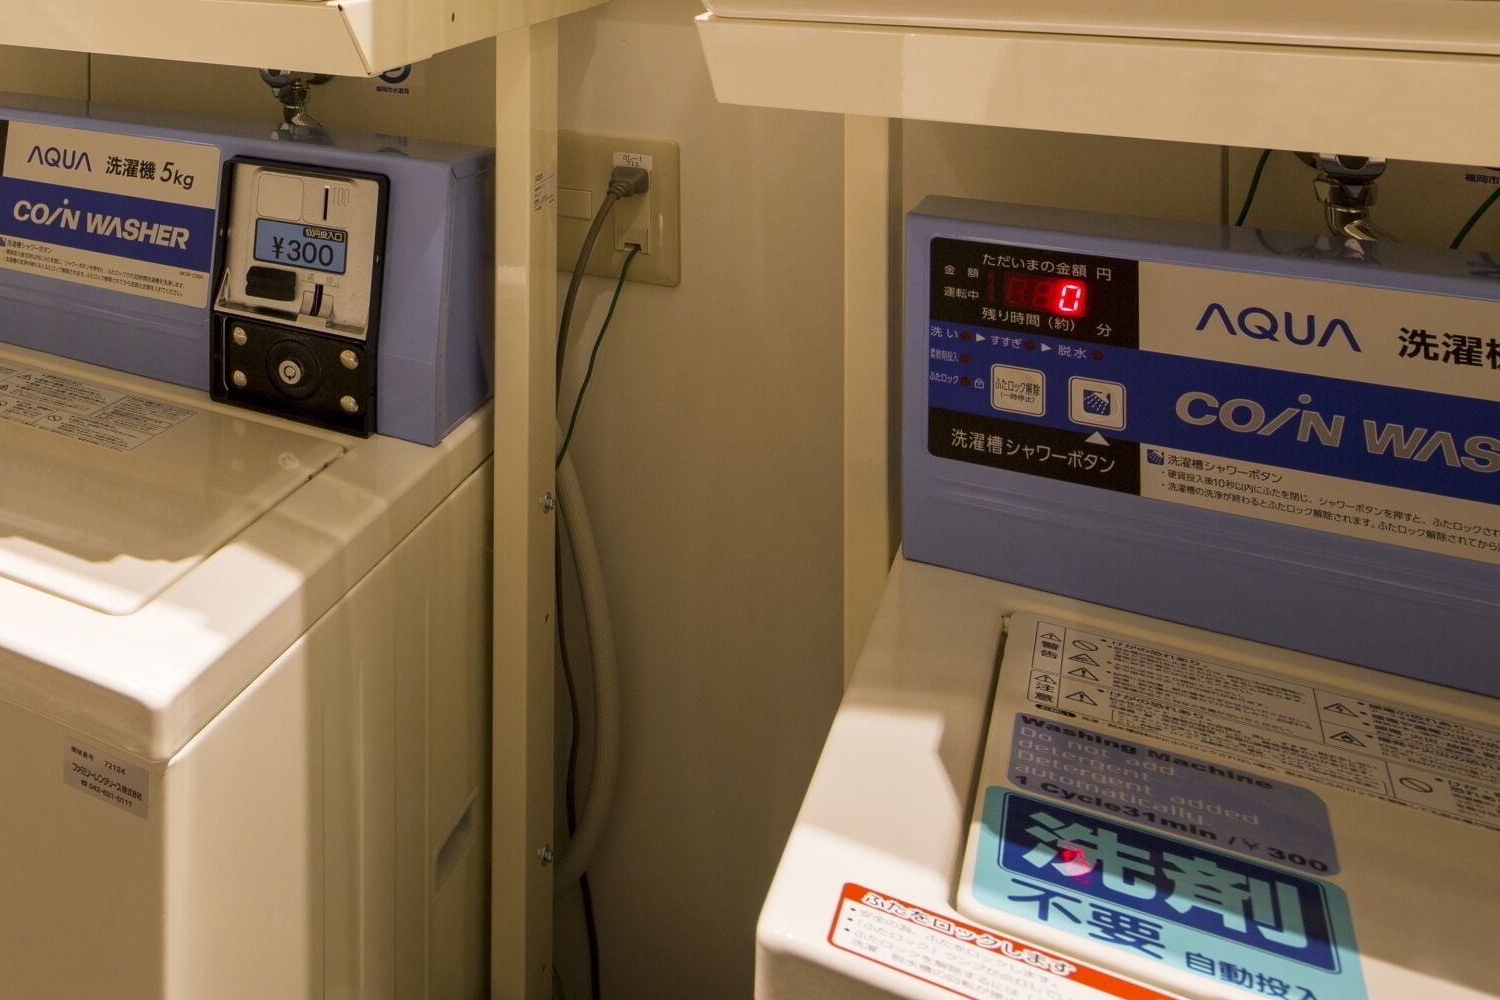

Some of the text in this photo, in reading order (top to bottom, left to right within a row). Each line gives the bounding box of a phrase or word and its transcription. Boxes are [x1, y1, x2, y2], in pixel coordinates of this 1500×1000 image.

[27, 145, 195, 190] AQUA 洗濯機 5kg
[13, 198, 190, 250] COIN WASHER
[271, 236, 334, 267] ¥300
[982, 253, 1112, 281] ただいまの金額 円
[943, 286, 980, 300] 運転中
[1059, 284, 1082, 312] 0
[990, 335, 1023, 349] すすぎ
[1058, 344, 1088, 359] 脱水
[1097, 323, 1112, 337] 分
[1196, 302, 1362, 353] AQUA
[951, 427, 1116, 474] 洗濯槽シャワーボタン
[1167, 453, 1284, 484] 洗濯槽シャワーボタン
[1018, 739, 1148, 783] detergent
[1020, 726, 1175, 777] Do not add
[1021, 714, 1274, 790] Washing Machine
[1017, 750, 1259, 827] Detergent added
[1021, 811, 1309, 950] 洗剤
[1266, 846, 1329, 874] 300
[863, 892, 1077, 977] ふたをロックします
[1007, 877, 1167, 961] 不要
